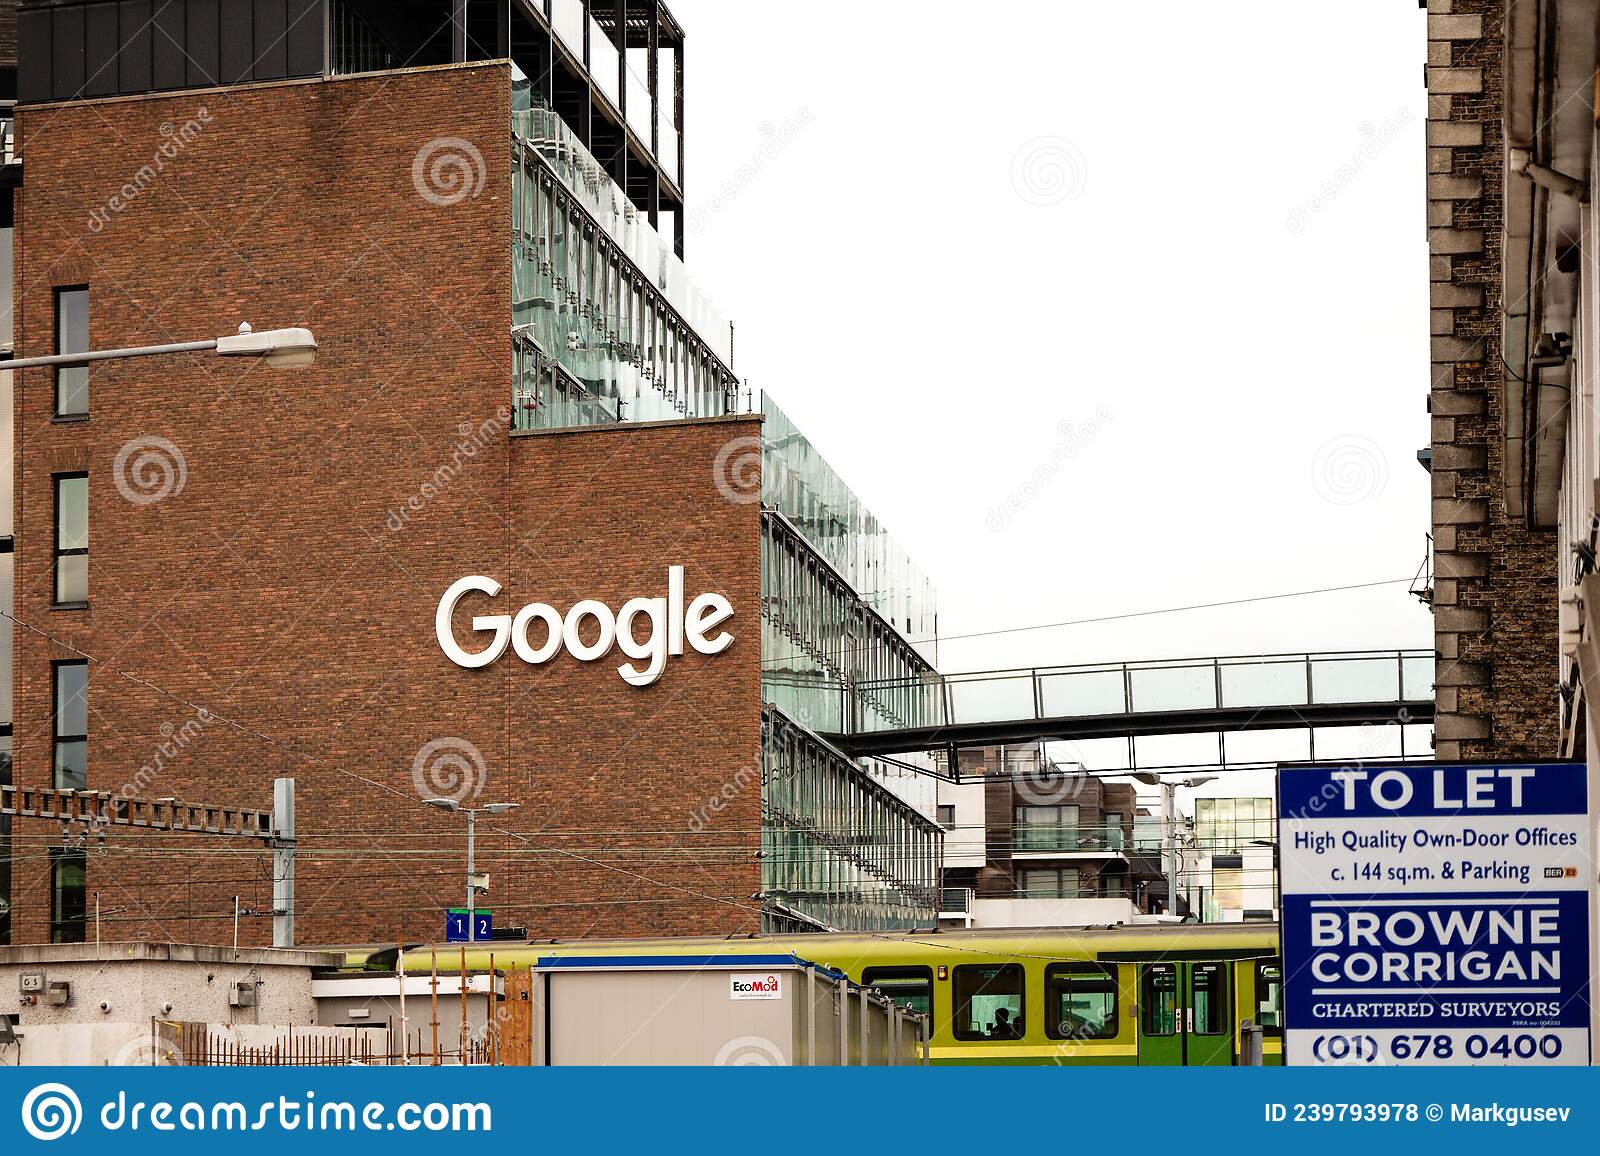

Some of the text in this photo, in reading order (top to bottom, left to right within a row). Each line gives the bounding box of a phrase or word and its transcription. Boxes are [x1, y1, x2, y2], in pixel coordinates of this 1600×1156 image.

[435, 565, 735, 686] Google
[1331, 768, 1535, 811] TO LET
[1295, 827, 1577, 854] High Quality Own-Door Offices
[1331, 860, 1530, 885] c. 144 sq.m. & Parking
[456, 919, 462, 934] 1
[480, 919, 487, 934] 2
[1311, 909, 1561, 947] BROWNE
[1311, 950, 1561, 983] CORRIGAN
[733, 979, 778, 992] EcoMod
[1312, 1001, 1561, 1018] CHARTERED SURVEYORS
[1312, 1034, 1563, 1063] (01) 678 0400
